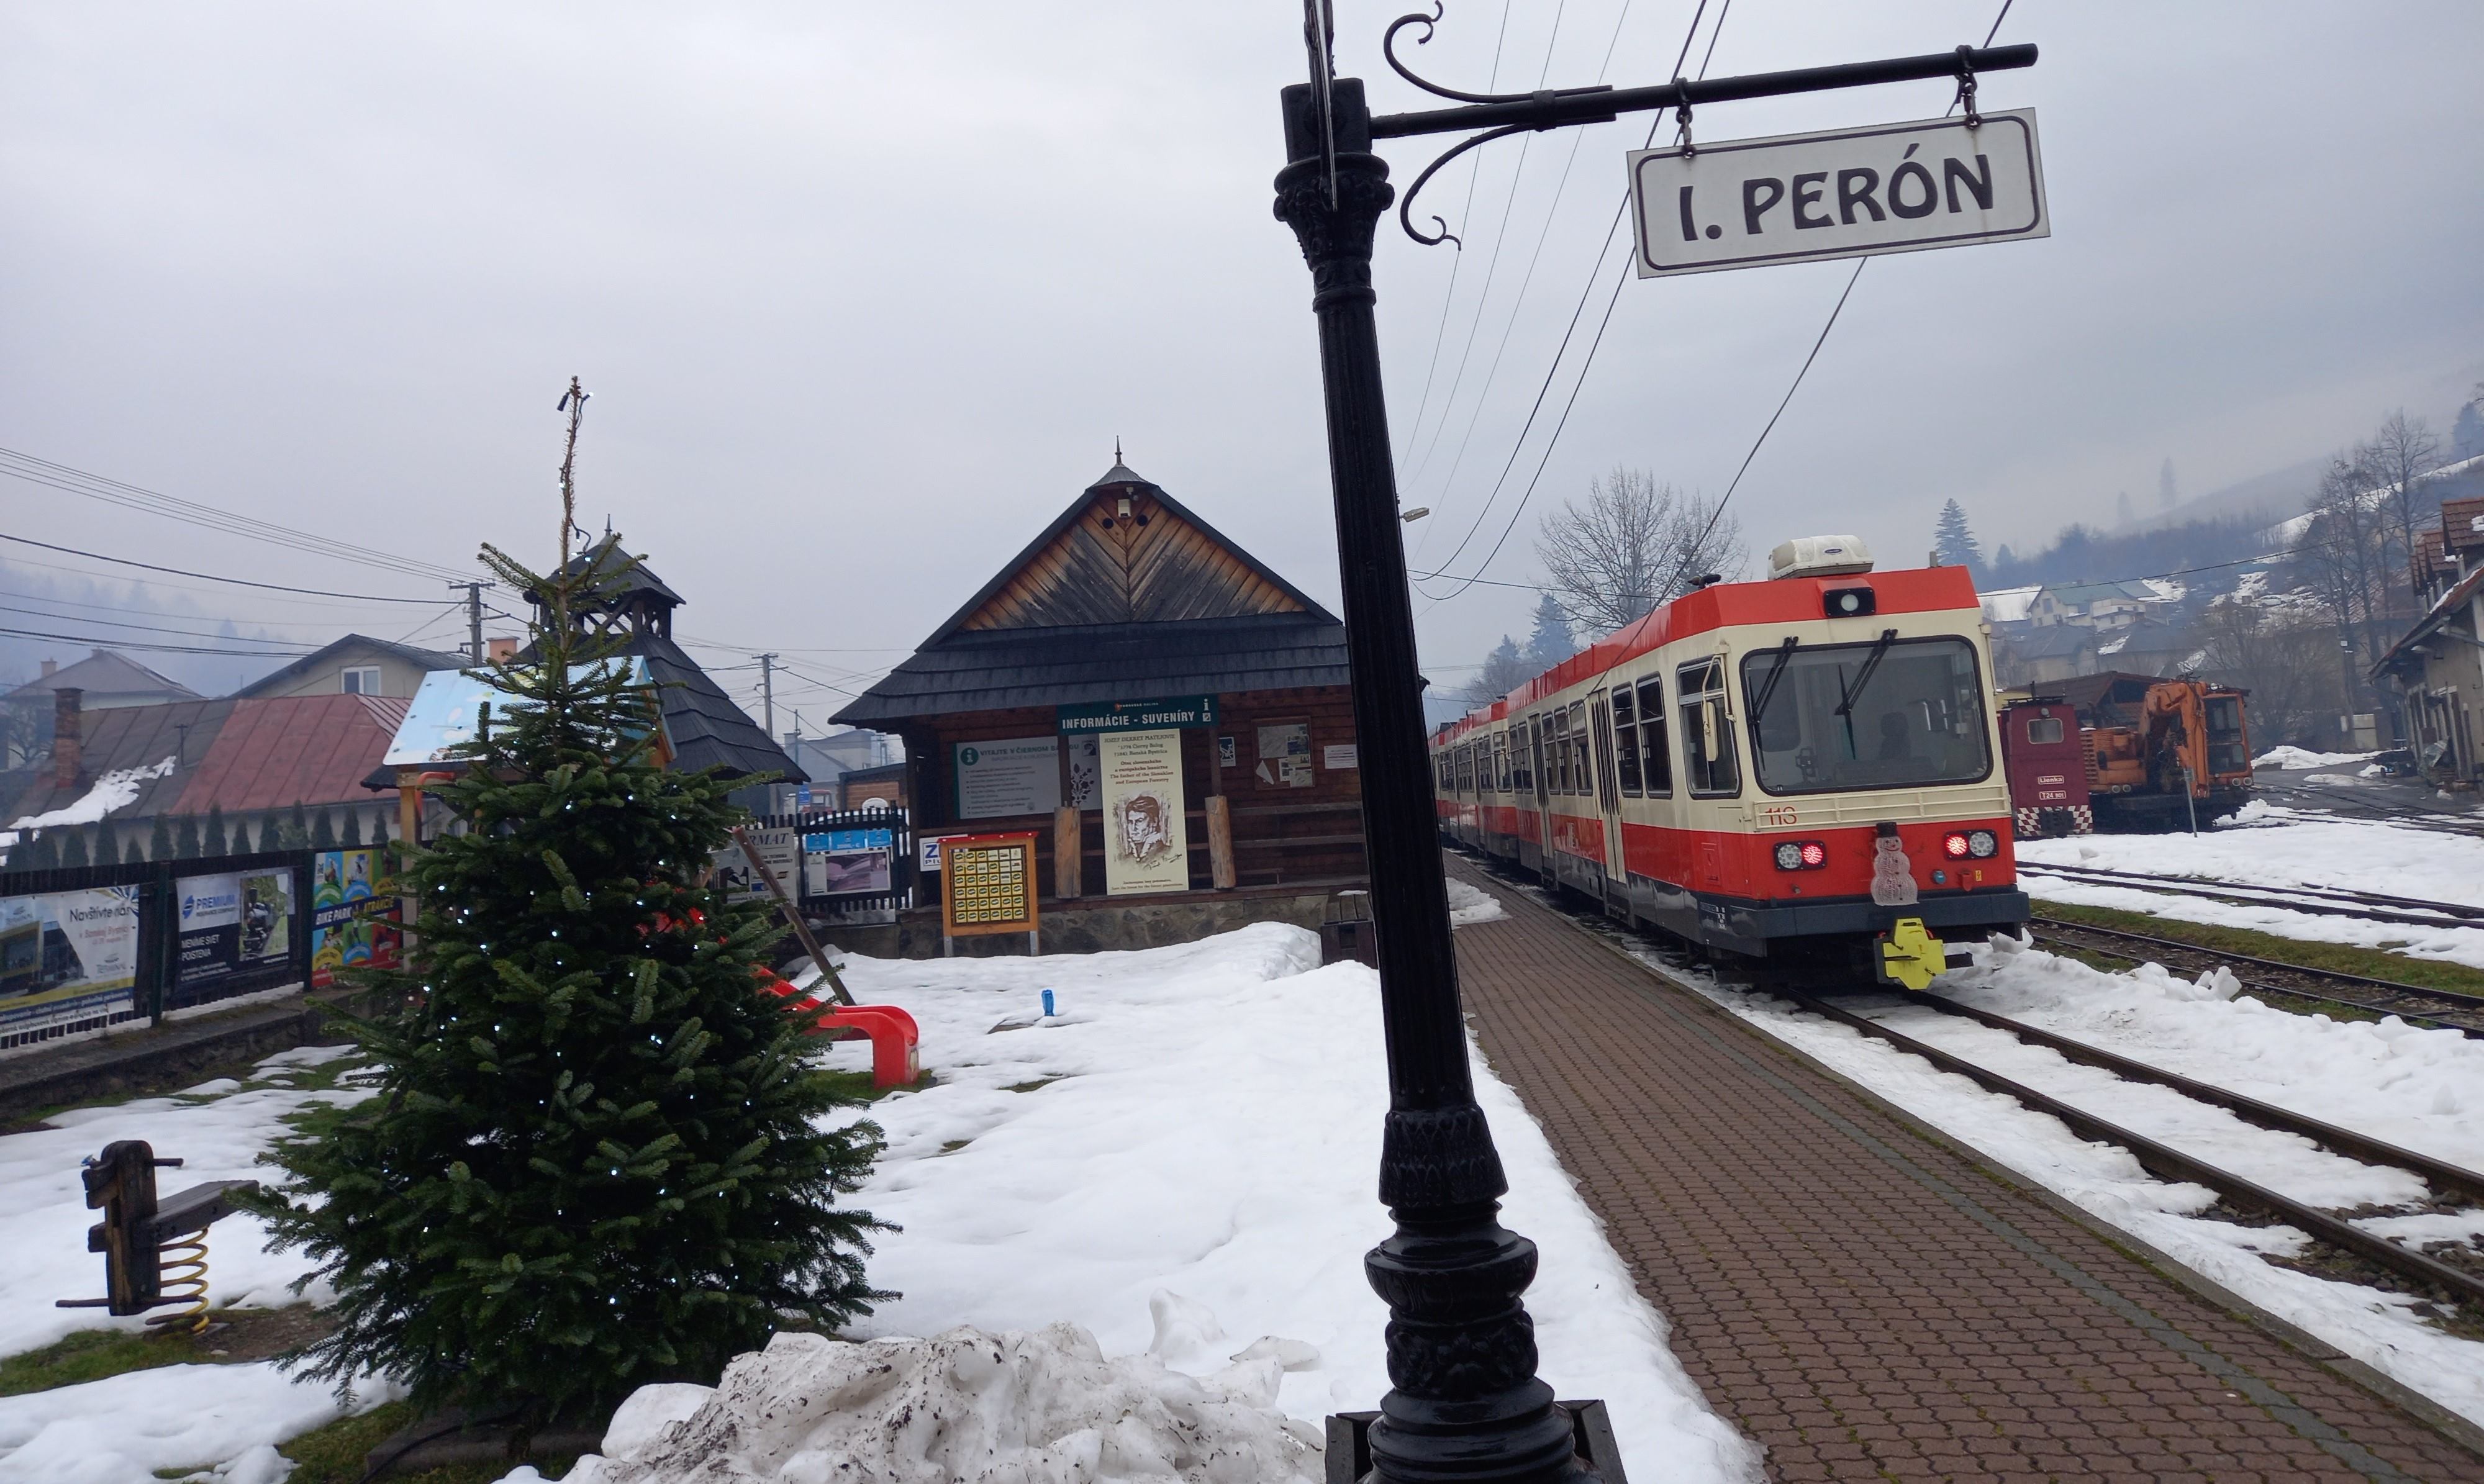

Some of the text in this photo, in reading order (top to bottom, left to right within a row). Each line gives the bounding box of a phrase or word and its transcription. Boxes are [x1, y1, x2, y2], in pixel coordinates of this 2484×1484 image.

[1679, 143, 1994, 242] I. PERÓN
[1062, 714, 1130, 730] INFORMÁCIE
[1142, 710, 1195, 725] SUVENÍRY
[1016, 745, 1049, 753] ČIERNOM
[1765, 807, 1798, 826] 113
[749, 833, 789, 846] RMAT
[196, 894, 235, 910] PREMIUM
[70, 906, 112, 923] Navštívte
[315, 910, 333, 925] BIKE
[333, 906, 353, 921] PARK
